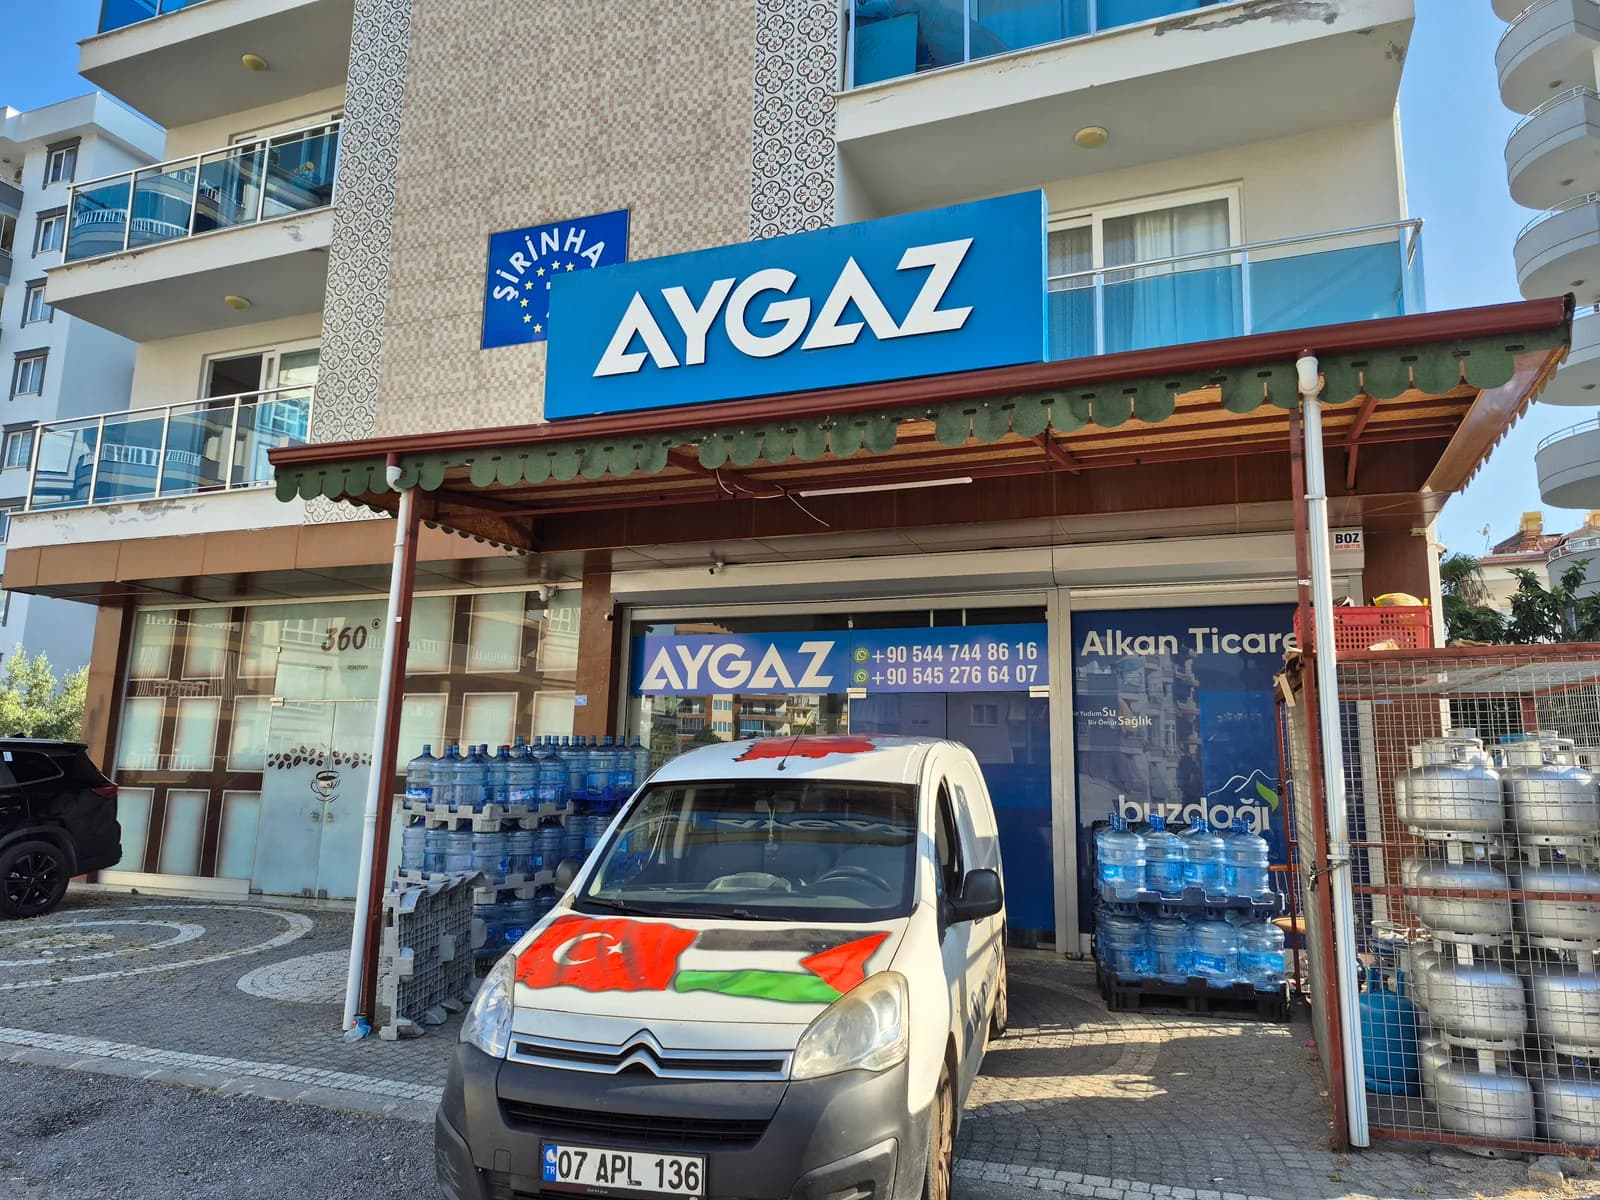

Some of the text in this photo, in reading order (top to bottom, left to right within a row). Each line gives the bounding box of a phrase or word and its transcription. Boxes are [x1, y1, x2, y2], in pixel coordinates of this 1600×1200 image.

[592, 237, 974, 377] AYGAZ
[1335, 532, 1360, 544] BOZ
[871, 641, 1038, 664] +90 544 744 86 16
[1080, 629, 1178, 656] Alkan
[639, 640, 835, 690] AYGAZ
[871, 664, 1038, 686] +90 545 276 64 07
[1102, 707, 1116, 717] Su
[1118, 715, 1153, 728] Sağlık
[545, 1150, 700, 1191] TR 07 APL 136
